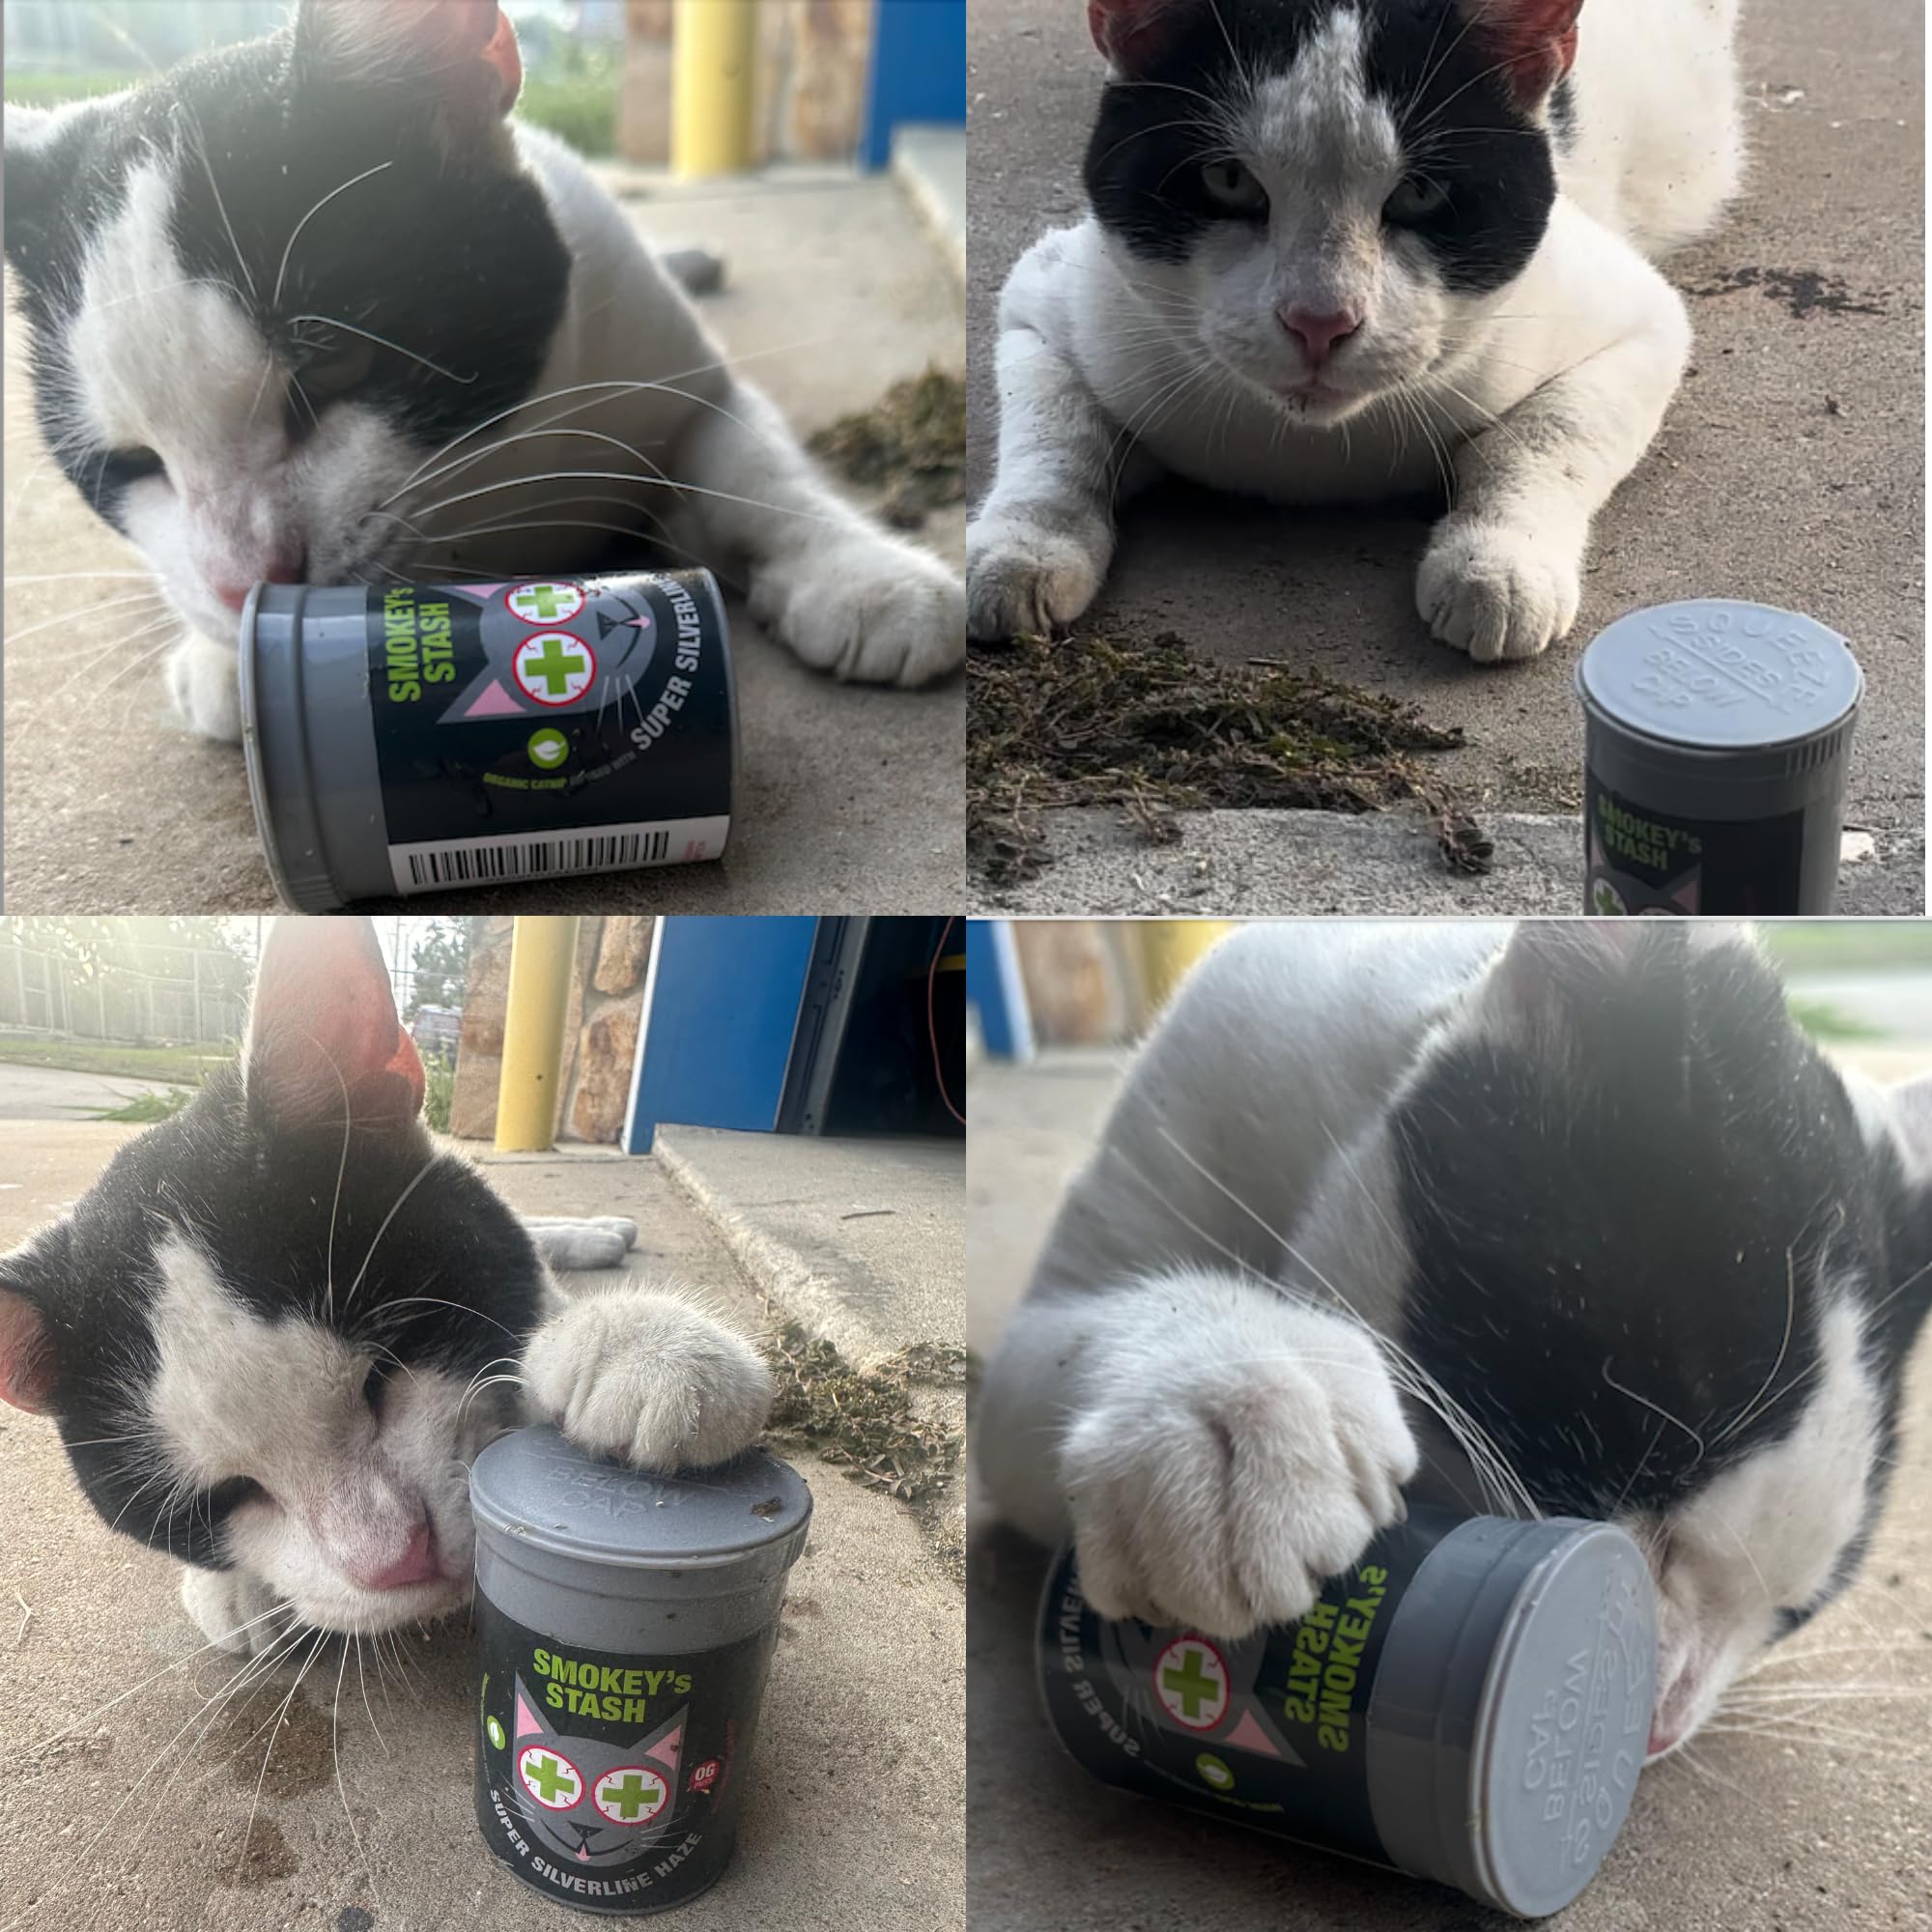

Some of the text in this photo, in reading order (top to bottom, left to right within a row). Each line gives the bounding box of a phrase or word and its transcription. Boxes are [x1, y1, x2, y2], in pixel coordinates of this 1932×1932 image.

[418, 602, 456, 683] STASH
[630, 675, 693, 751] SUPER
[1605, 822, 1667, 870] STASH
[546, 1682, 646, 1723] STASH
[695, 1763, 716, 1781] OG
[490, 1789, 703, 1896] SUPER SILVERLINE HAZE
